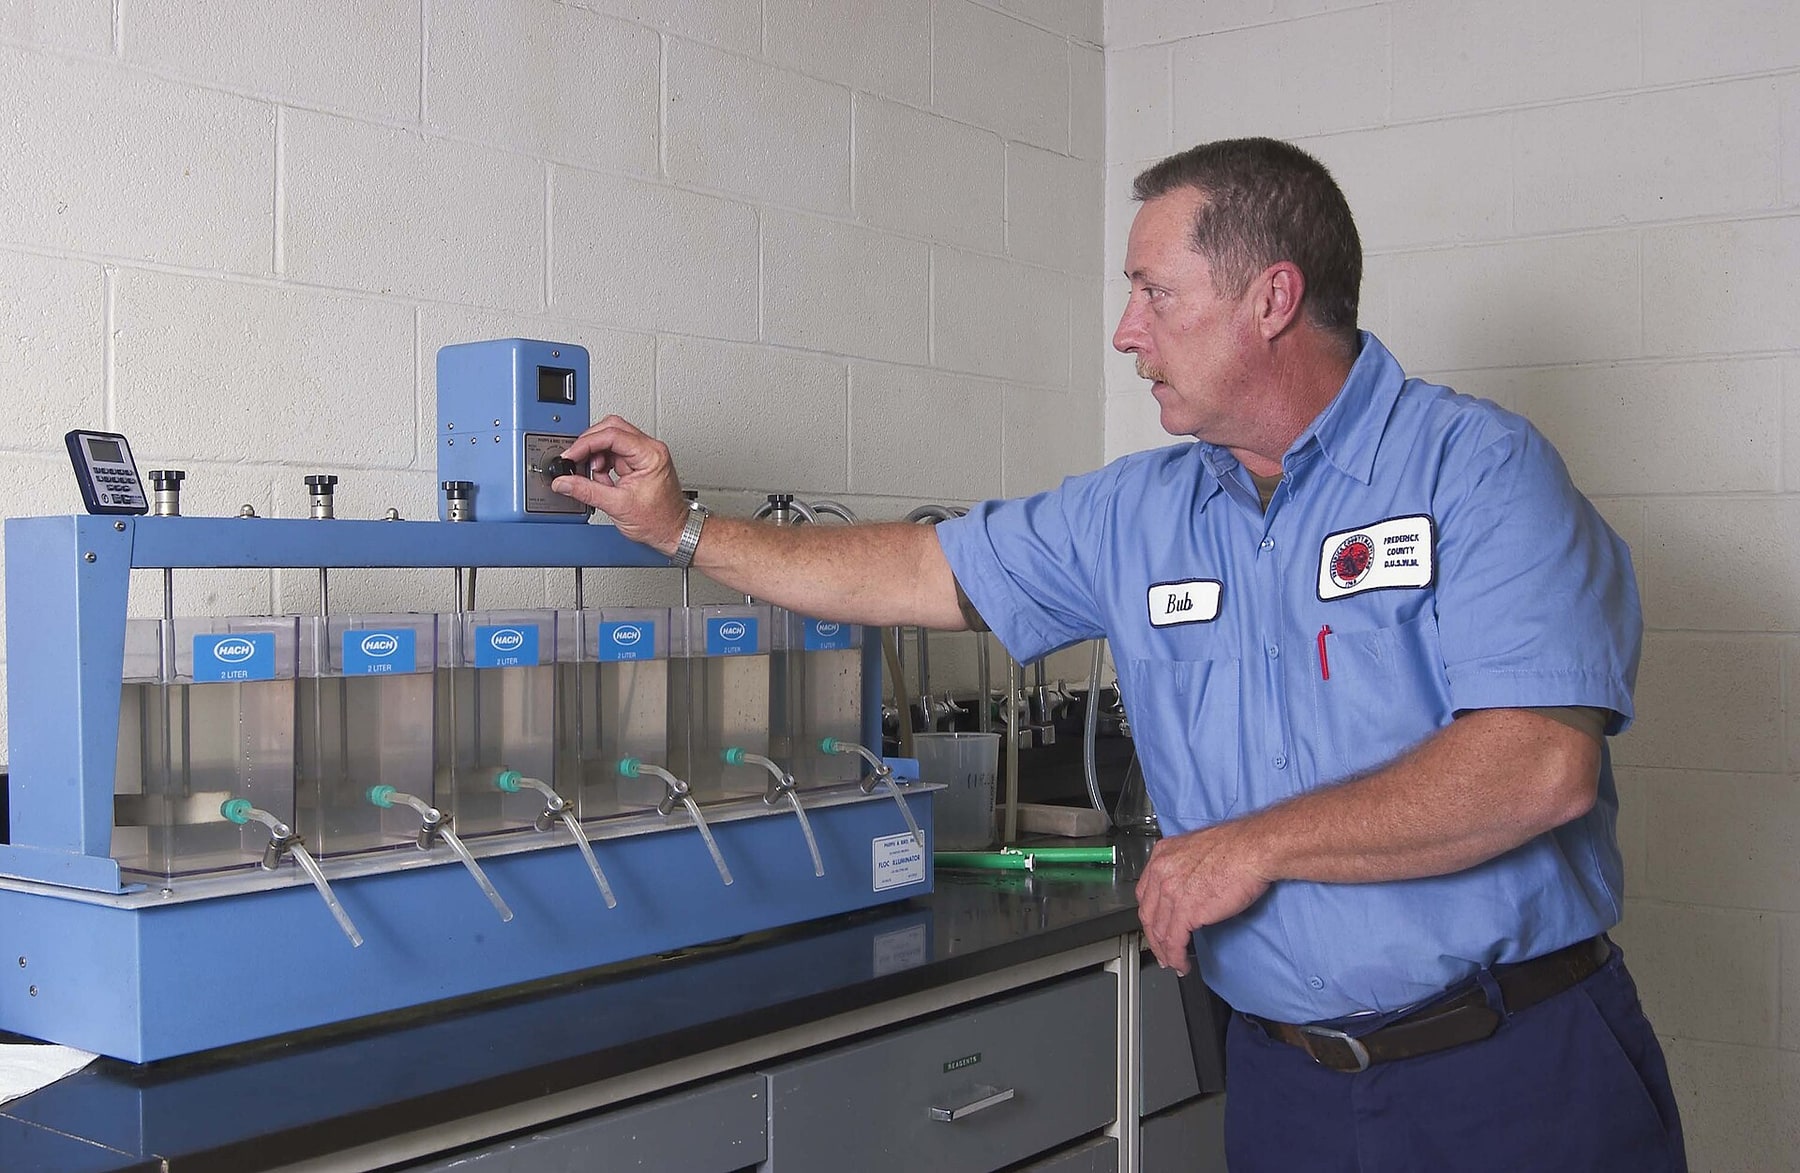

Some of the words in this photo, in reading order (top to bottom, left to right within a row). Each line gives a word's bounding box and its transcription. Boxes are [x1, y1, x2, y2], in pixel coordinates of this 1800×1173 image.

[1383, 534, 1419, 545] FREDERICK
[1387, 546, 1415, 556] COUNTY
[1165, 592, 1193, 614] Bub
[722, 627, 744, 635] HACH
[819, 624, 837, 632] HACH
[494, 635, 520, 645] HACH
[616, 631, 638, 640] HACH
[365, 640, 394, 650] HACH
[218, 645, 250, 656] HACH
[622, 651, 637, 659] LITER
[501, 657, 518, 665] LITER
[373, 664, 392, 672] LITER
[226, 670, 248, 679] LITER
[892, 854, 920, 865] ILLUMINATOR
